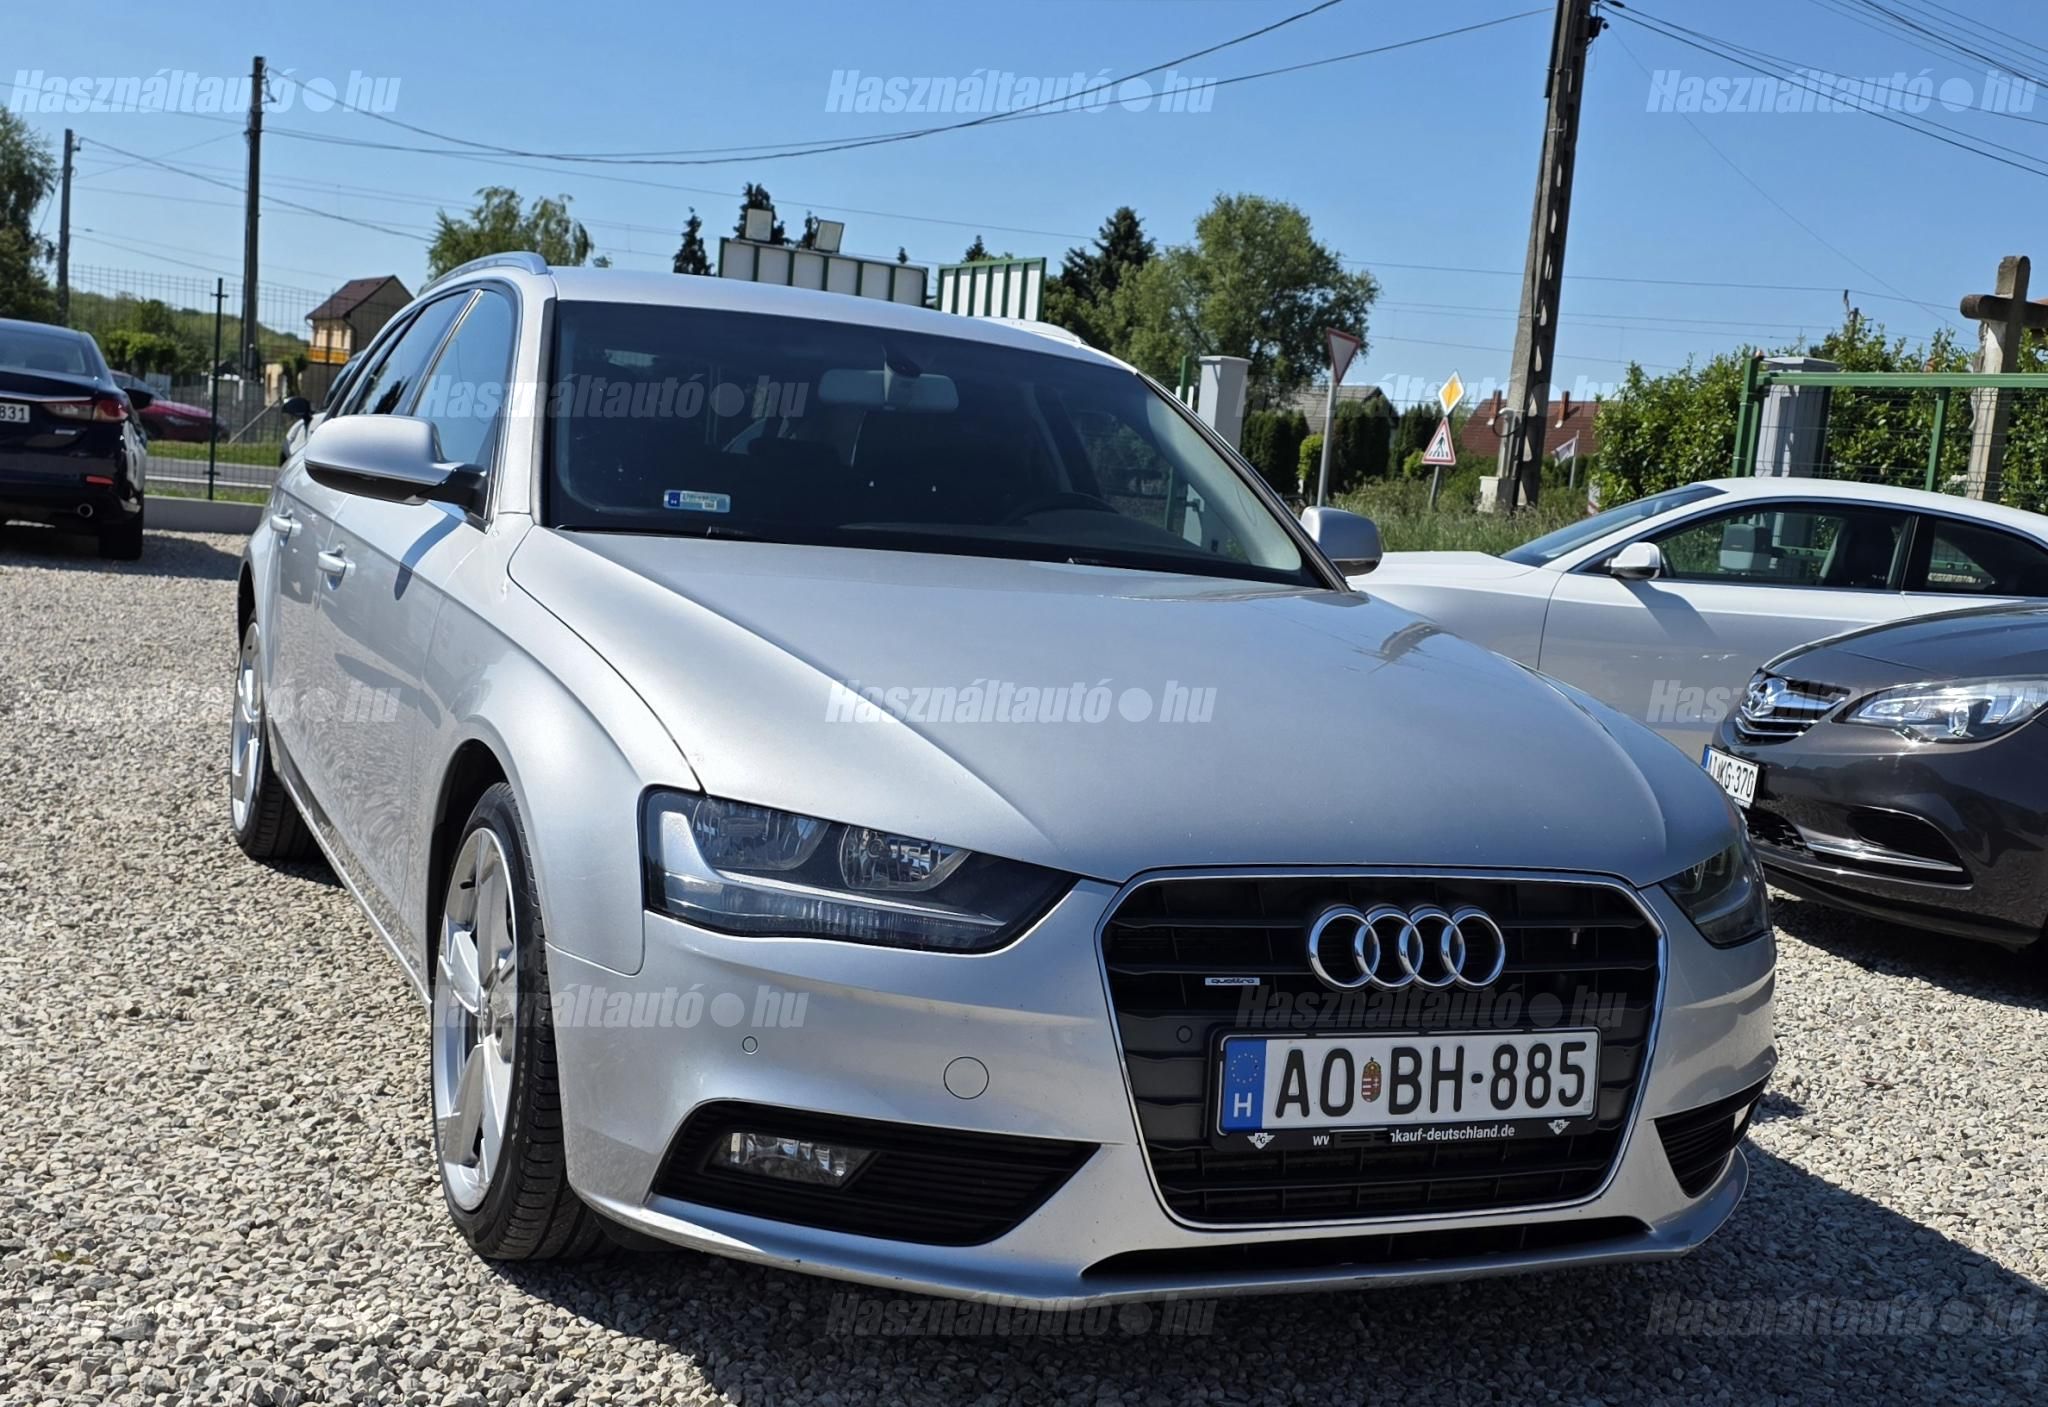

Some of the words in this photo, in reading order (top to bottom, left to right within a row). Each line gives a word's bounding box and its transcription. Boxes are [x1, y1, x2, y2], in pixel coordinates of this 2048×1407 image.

[1209, 977, 1256, 985] quattro
[1275, 1047, 1356, 1118] AO
[1233, 1092, 1252, 1118] H
